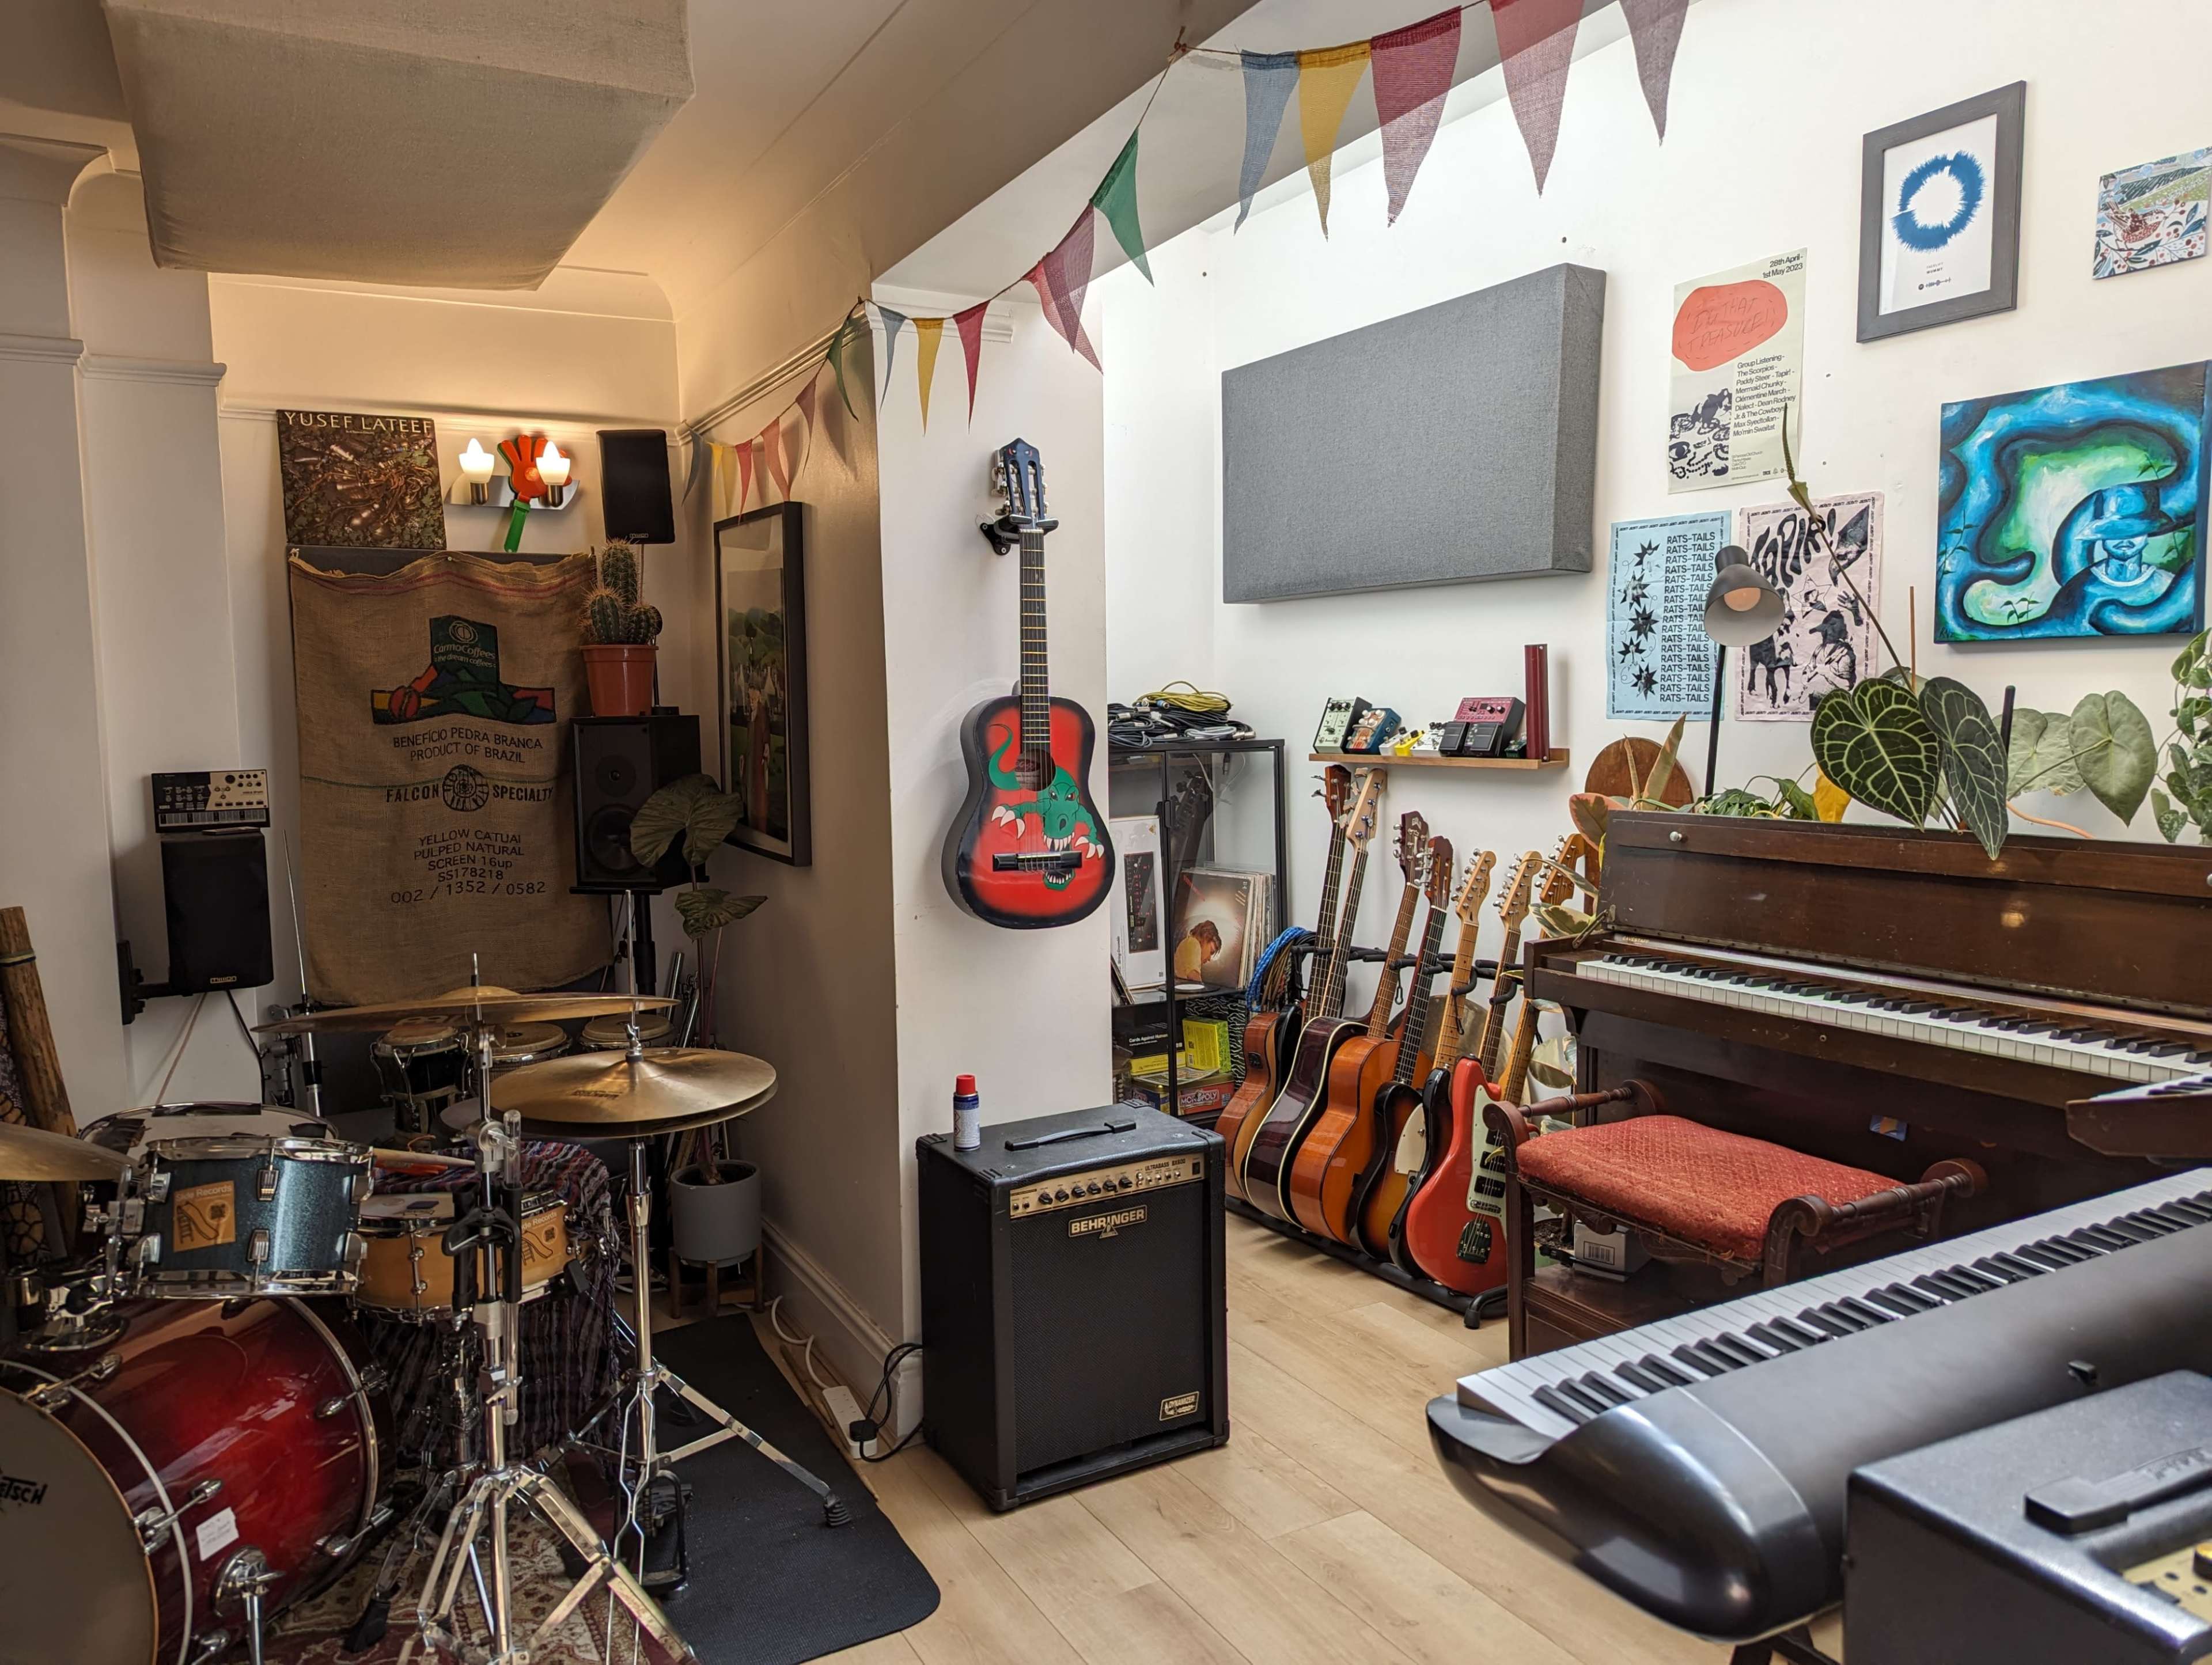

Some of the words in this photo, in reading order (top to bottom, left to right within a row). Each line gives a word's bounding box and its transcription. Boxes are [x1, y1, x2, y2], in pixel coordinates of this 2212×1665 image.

[1769, 258, 1785, 268] 28th
[1785, 253, 1800, 263] April
[1763, 271, 1771, 279] 1st
[1771, 268, 1785, 276] May
[1785, 263, 1803, 272] 2023
[1722, 297, 1758, 317] THAT
[1737, 359, 1755, 369] Group
[1756, 354, 1782, 365] Listening
[1749, 365, 1774, 374] Scorpios
[1736, 378, 1755, 386] Paddy
[1755, 374, 1771, 382] Steer
[1775, 369, 1791, 378] Tapir!
[1736, 385, 1760, 395] Mermaid
[1761, 380, 1783, 389] Chunky
[1768, 388, 1786, 396] March
[1735, 403, 1754, 411] Dialect
[1773, 395, 1796, 404] Rodney
[1747, 410, 1758, 418] The
[285, 412, 352, 428] YUSEF
[362, 417, 431, 433] LATEEF
[1734, 420, 1746, 428] Max
[1667, 532, 1715, 544] RATS-TAILS
[1666, 542, 1715, 554] RATS-TAILS
[1665, 552, 1714, 564] RATS-TAILS
[1665, 563, 1714, 574] RATS-TAILS
[1664, 573, 1713, 584] RATS-TAILS
[1664, 583, 1712, 594] RATS-TAILS
[1664, 604, 1705, 613] RATS-TAIL
[1662, 613, 1704, 623] RATS-TAIL
[1662, 624, 1705, 633] RATS-TAIL
[1661, 634, 1709, 643] RATS-TAILS
[434, 644, 495, 659] CarmoCoffees
[1661, 644, 1709, 653] RATS-TAILS
[447, 654, 468, 663] dream
[1661, 654, 1709, 662] RATS-TAILS
[1661, 664, 1710, 673] RATS-TAILS
[1661, 674, 1710, 682] RATS-TAILS
[1660, 684, 1710, 692] RATS-TAILS
[1660, 693, 1710, 703] RATS-TAILS
[451, 727, 490, 743] PEDRA
[494, 734, 543, 749] BRANCA
[410, 742, 461, 761] PRODUCT
[465, 743, 480, 755] OF
[485, 746, 525, 763] BRAZIL
[386, 784, 439, 802] FALCON
[493, 784, 554, 802] SPECIALTY
[419, 829, 470, 846] YELLOW
[474, 830, 521, 844] CATUAI
[414, 843, 461, 860] PULPED
[466, 842, 524, 856] NATURAL
[428, 855, 476, 871] SCREEN
[481, 856, 513, 869] 16up
[438, 867, 503, 882] SS178218
[391, 889, 423, 903] 002
[429, 886, 438, 900] /
[446, 881, 485, 896] 1352
[491, 883, 501, 894] /
[506, 881, 546, 896] 0582
[1145, 1162, 1169, 1171] ULTRABASS
[196, 1185, 232, 1196] Records
[533, 1212, 557, 1225] Records
[1071, 1209, 1145, 1234] BEHRINGER
